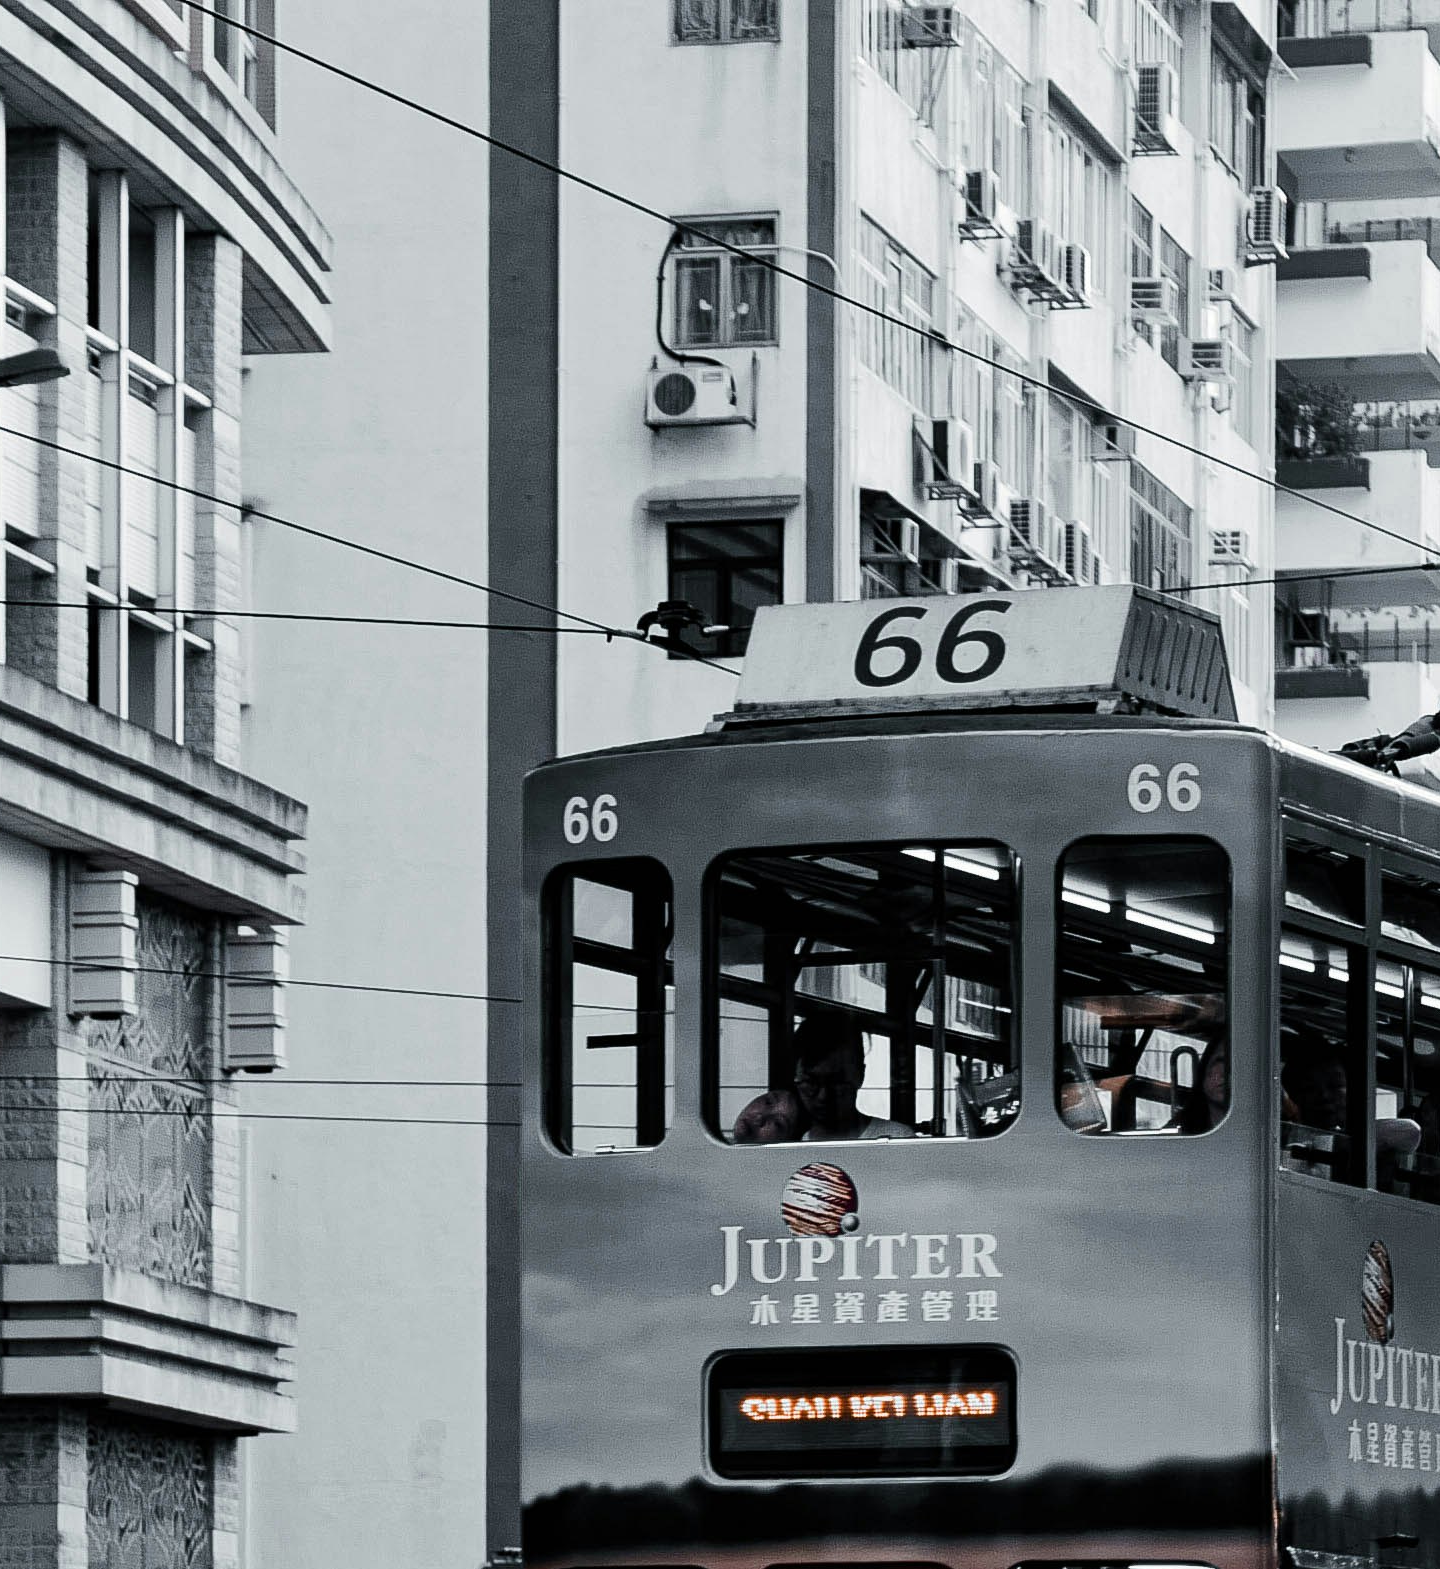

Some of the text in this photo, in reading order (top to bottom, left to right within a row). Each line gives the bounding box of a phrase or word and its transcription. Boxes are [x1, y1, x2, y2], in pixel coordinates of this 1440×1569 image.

[855, 599, 1012, 687] 66
[1127, 762, 1201, 814] 66
[563, 794, 618, 844] 66
[710, 1226, 1003, 1296] JUPITER
[749, 1290, 1000, 1325] 木星資產管理
